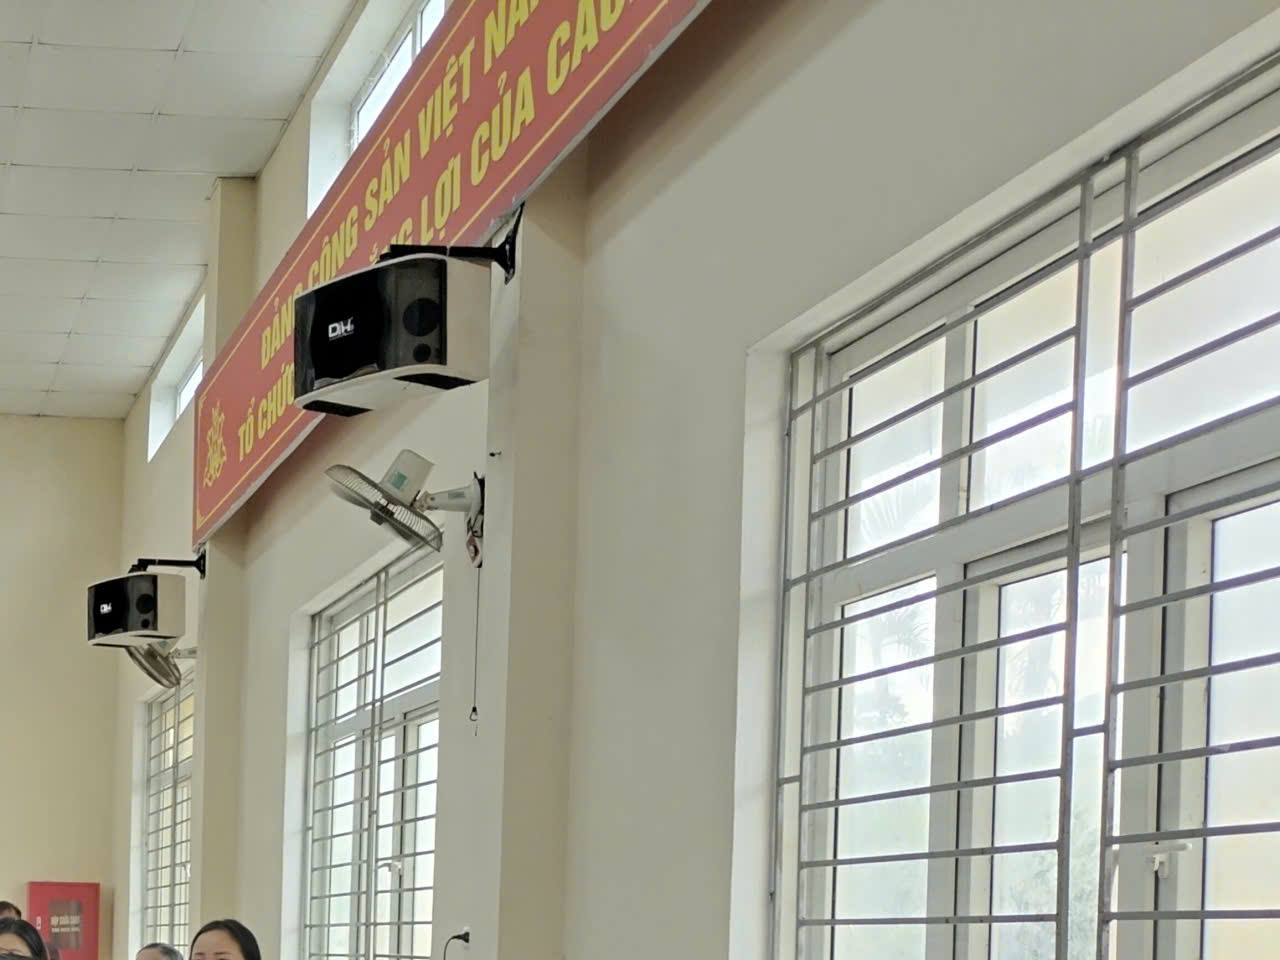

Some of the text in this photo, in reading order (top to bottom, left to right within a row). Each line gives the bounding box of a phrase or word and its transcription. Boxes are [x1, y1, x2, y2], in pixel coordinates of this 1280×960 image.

[238, 396, 255, 462] TỔ
[471, 65, 536, 186] CỦA
[364, 128, 411, 231] SẢN
[418, 36, 475, 159] VIỆT
[484, 0, 540, 75] NA
